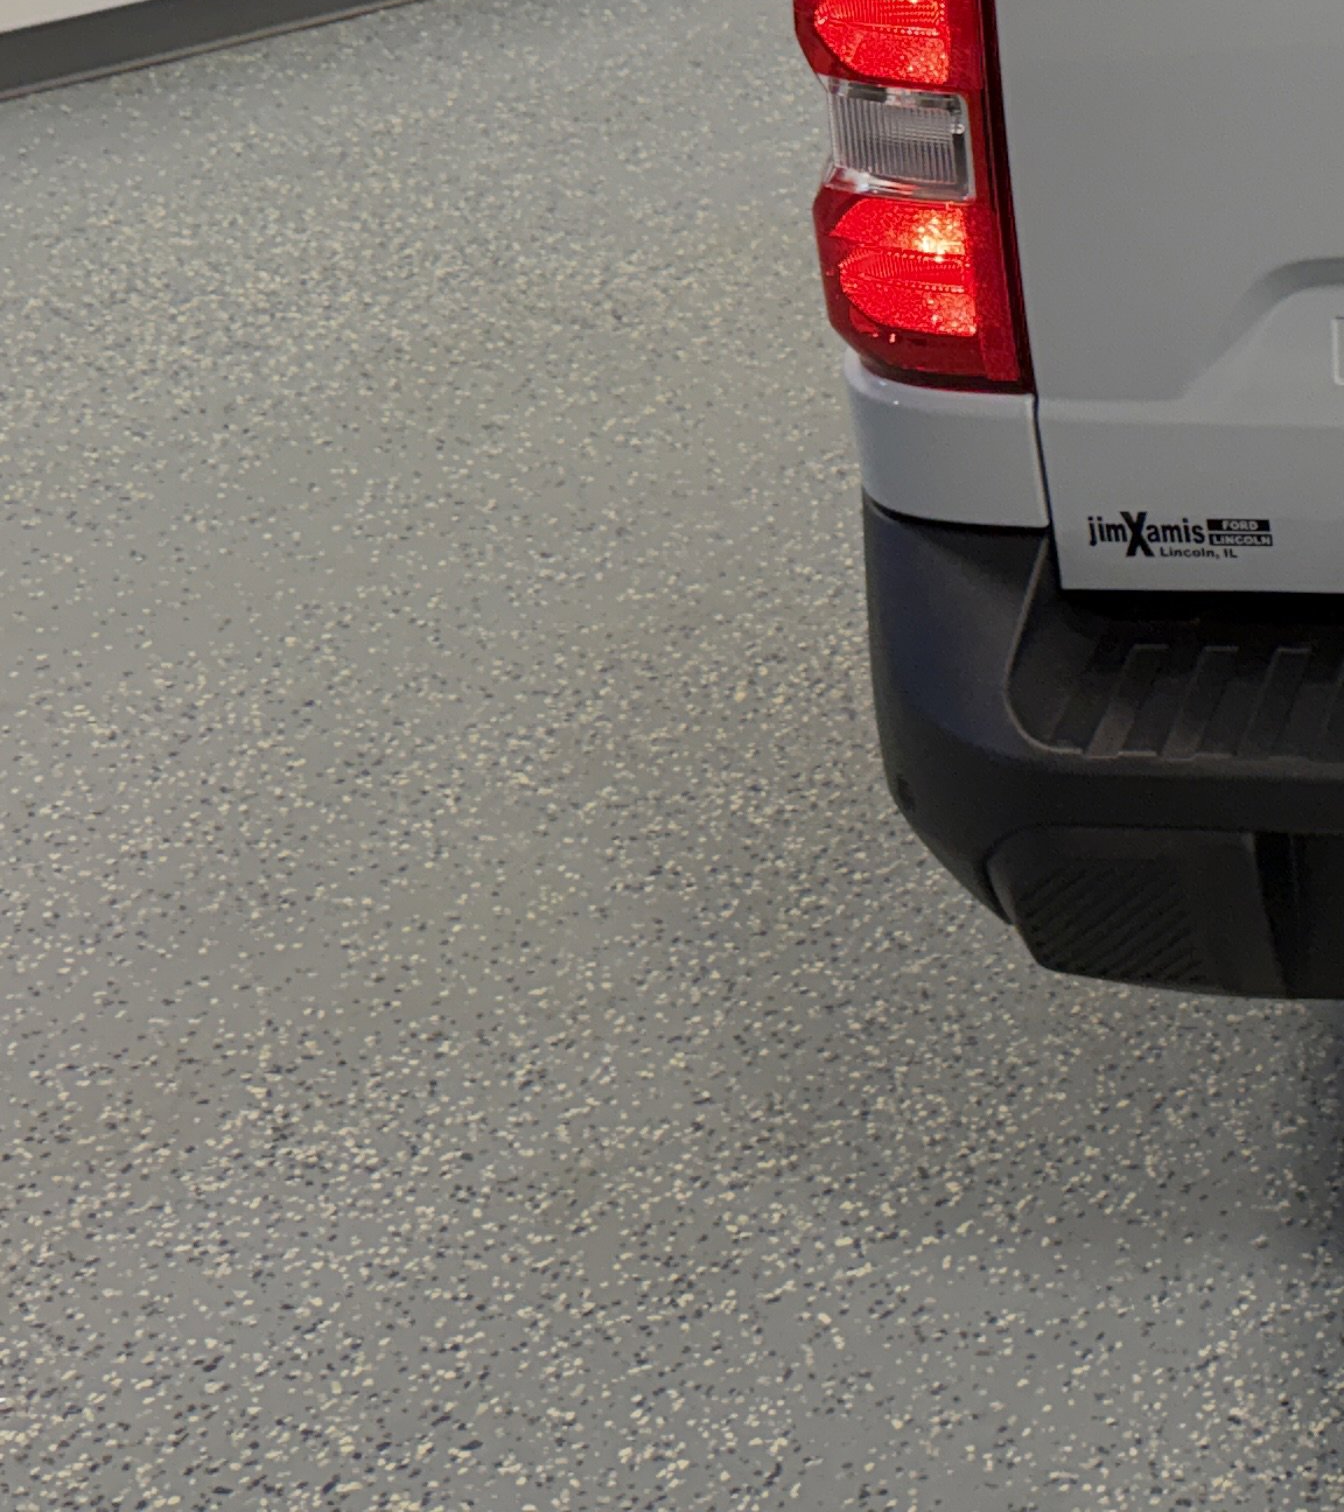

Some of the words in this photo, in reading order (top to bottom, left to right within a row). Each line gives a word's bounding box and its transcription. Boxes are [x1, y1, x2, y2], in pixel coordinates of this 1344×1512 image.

[1222, 520, 1259, 531] FORD
[1213, 534, 1271, 546] LINCOLN
[1160, 547, 1219, 559] Lincoln,
[1224, 548, 1238, 558] IL
